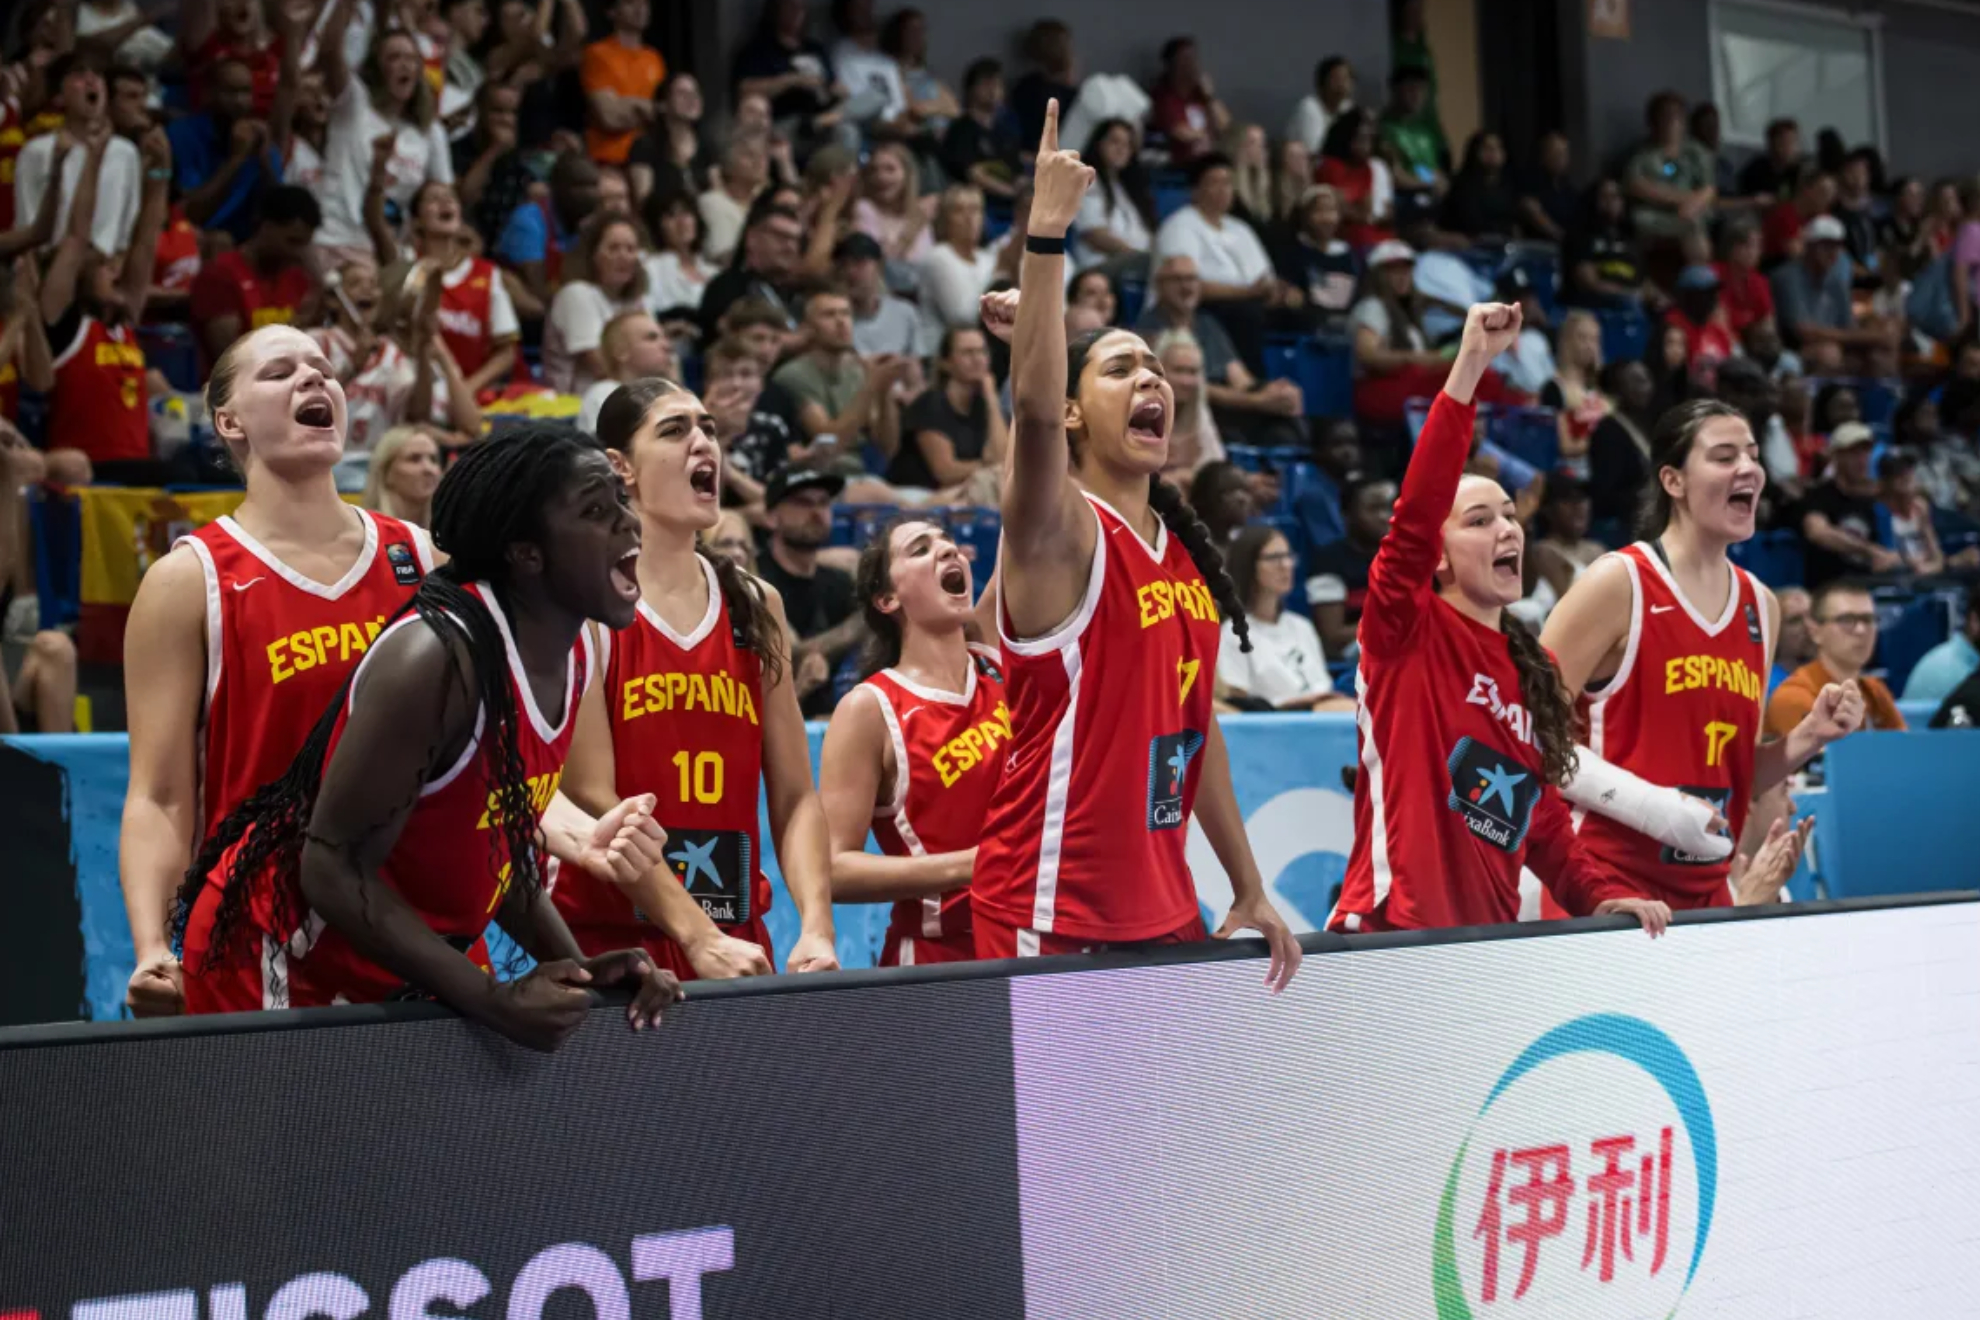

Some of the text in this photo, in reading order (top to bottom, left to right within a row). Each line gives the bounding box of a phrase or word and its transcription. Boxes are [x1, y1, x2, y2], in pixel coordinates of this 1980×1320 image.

[266, 615, 386, 684] ESPA
[623, 670, 759, 726] ESPAÑA
[931, 700, 1013, 789] ESPA
[1704, 721, 1738, 767] 17
[672, 750, 724, 804] 10
[1464, 811, 1511, 848] ixaBank
[1473, 1125, 1673, 1303] 伊利
[72, 1225, 736, 1320] SOT
